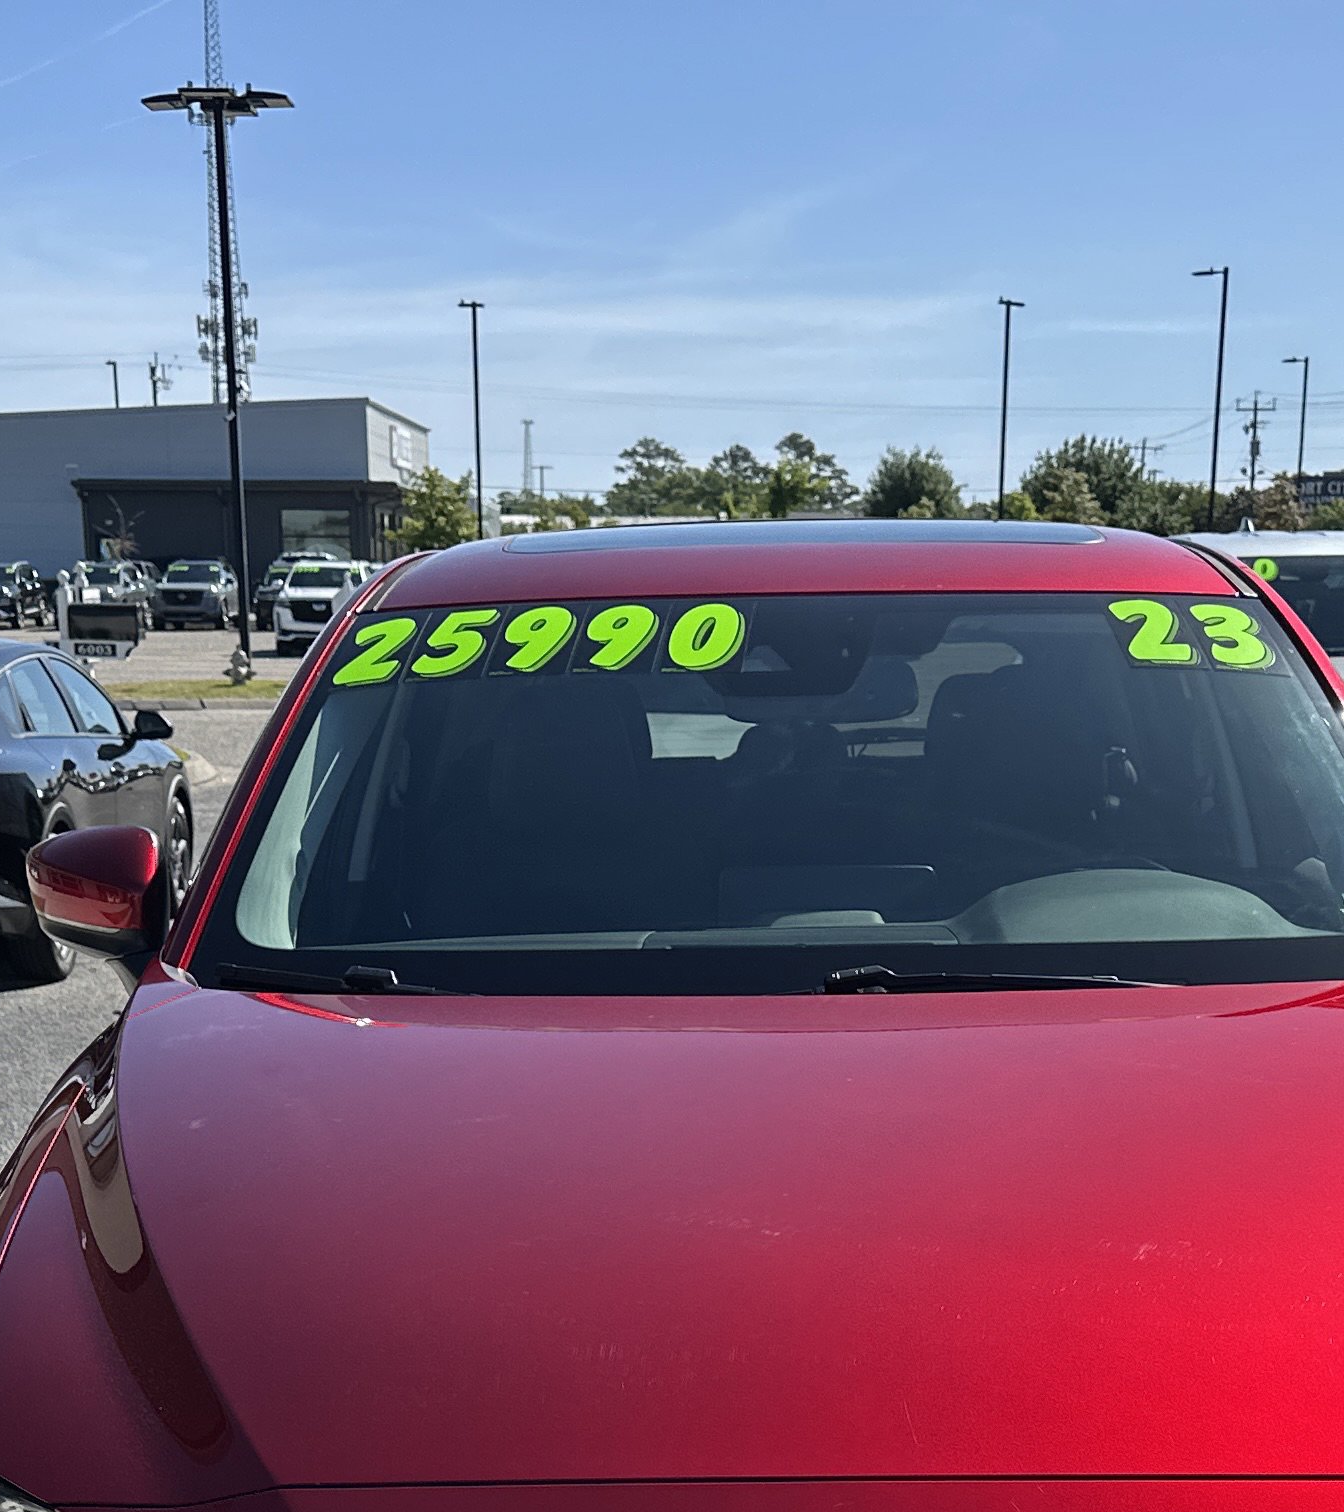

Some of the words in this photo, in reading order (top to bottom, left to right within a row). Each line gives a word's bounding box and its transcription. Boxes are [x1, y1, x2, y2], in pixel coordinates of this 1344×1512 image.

[78, 644, 113, 656] 6003
[333, 603, 746, 687] 25990
[1108, 600, 1276, 669] 23
